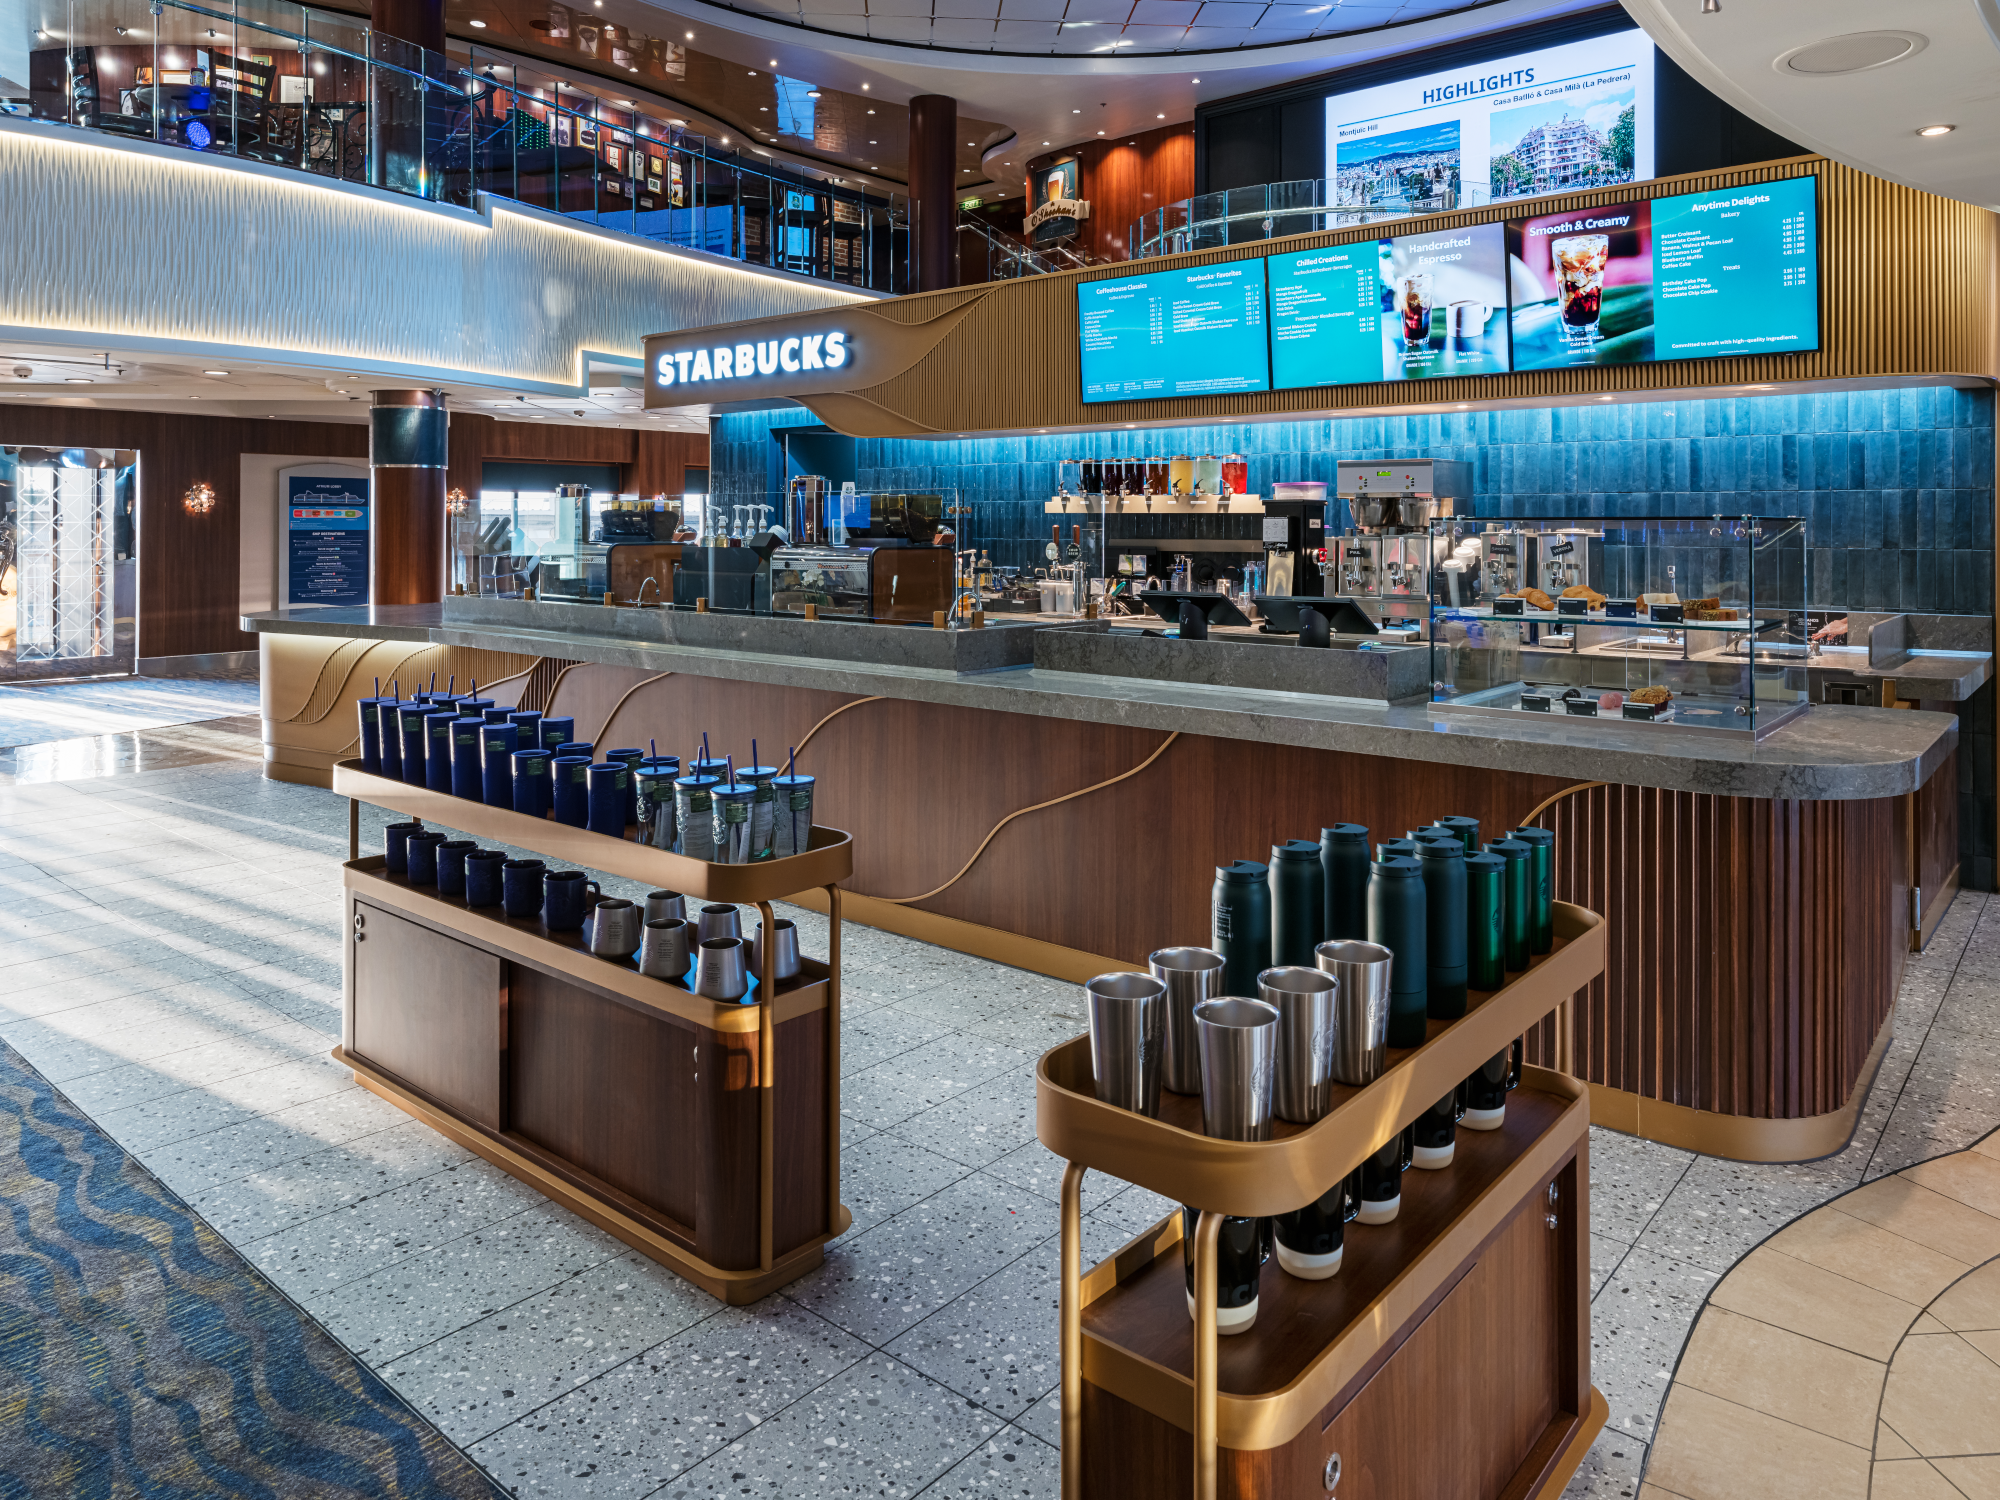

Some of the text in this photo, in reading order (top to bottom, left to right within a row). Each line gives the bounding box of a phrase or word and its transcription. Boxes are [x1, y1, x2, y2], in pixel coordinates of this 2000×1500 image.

[1423, 68, 1535, 104] HIGHLIGHTS
[1494, 98, 1511, 106] Casa
[1513, 92, 1535, 103] Batlló
[1544, 87, 1563, 96] Casa
[1565, 83, 1581, 93] Milà
[1582, 81, 1595, 89] (La
[1597, 73, 1631, 86] Pedrera)
[1340, 127, 1366, 137] Montjuïc
[1692, 195, 1770, 212] Anytime Delights
[1031, 203, 1076, 227] O'Sheehan's
[1529, 216, 1630, 236] Smooth & Creamy
[1409, 236, 1471, 253] Handcrafted
[1687, 235, 1710, 243] Croissant
[1297, 255, 1348, 267] Chilled Creations
[1419, 253, 1462, 265] Espresso
[1662, 256, 1685, 264] Blueberry
[1187, 270, 1242, 282] Starbucks Favorites
[1096, 283, 1147, 295] Coffeehouse Classics
[1663, 285, 1687, 293] Chocolate
[658, 332, 845, 386] STARBUCKS
